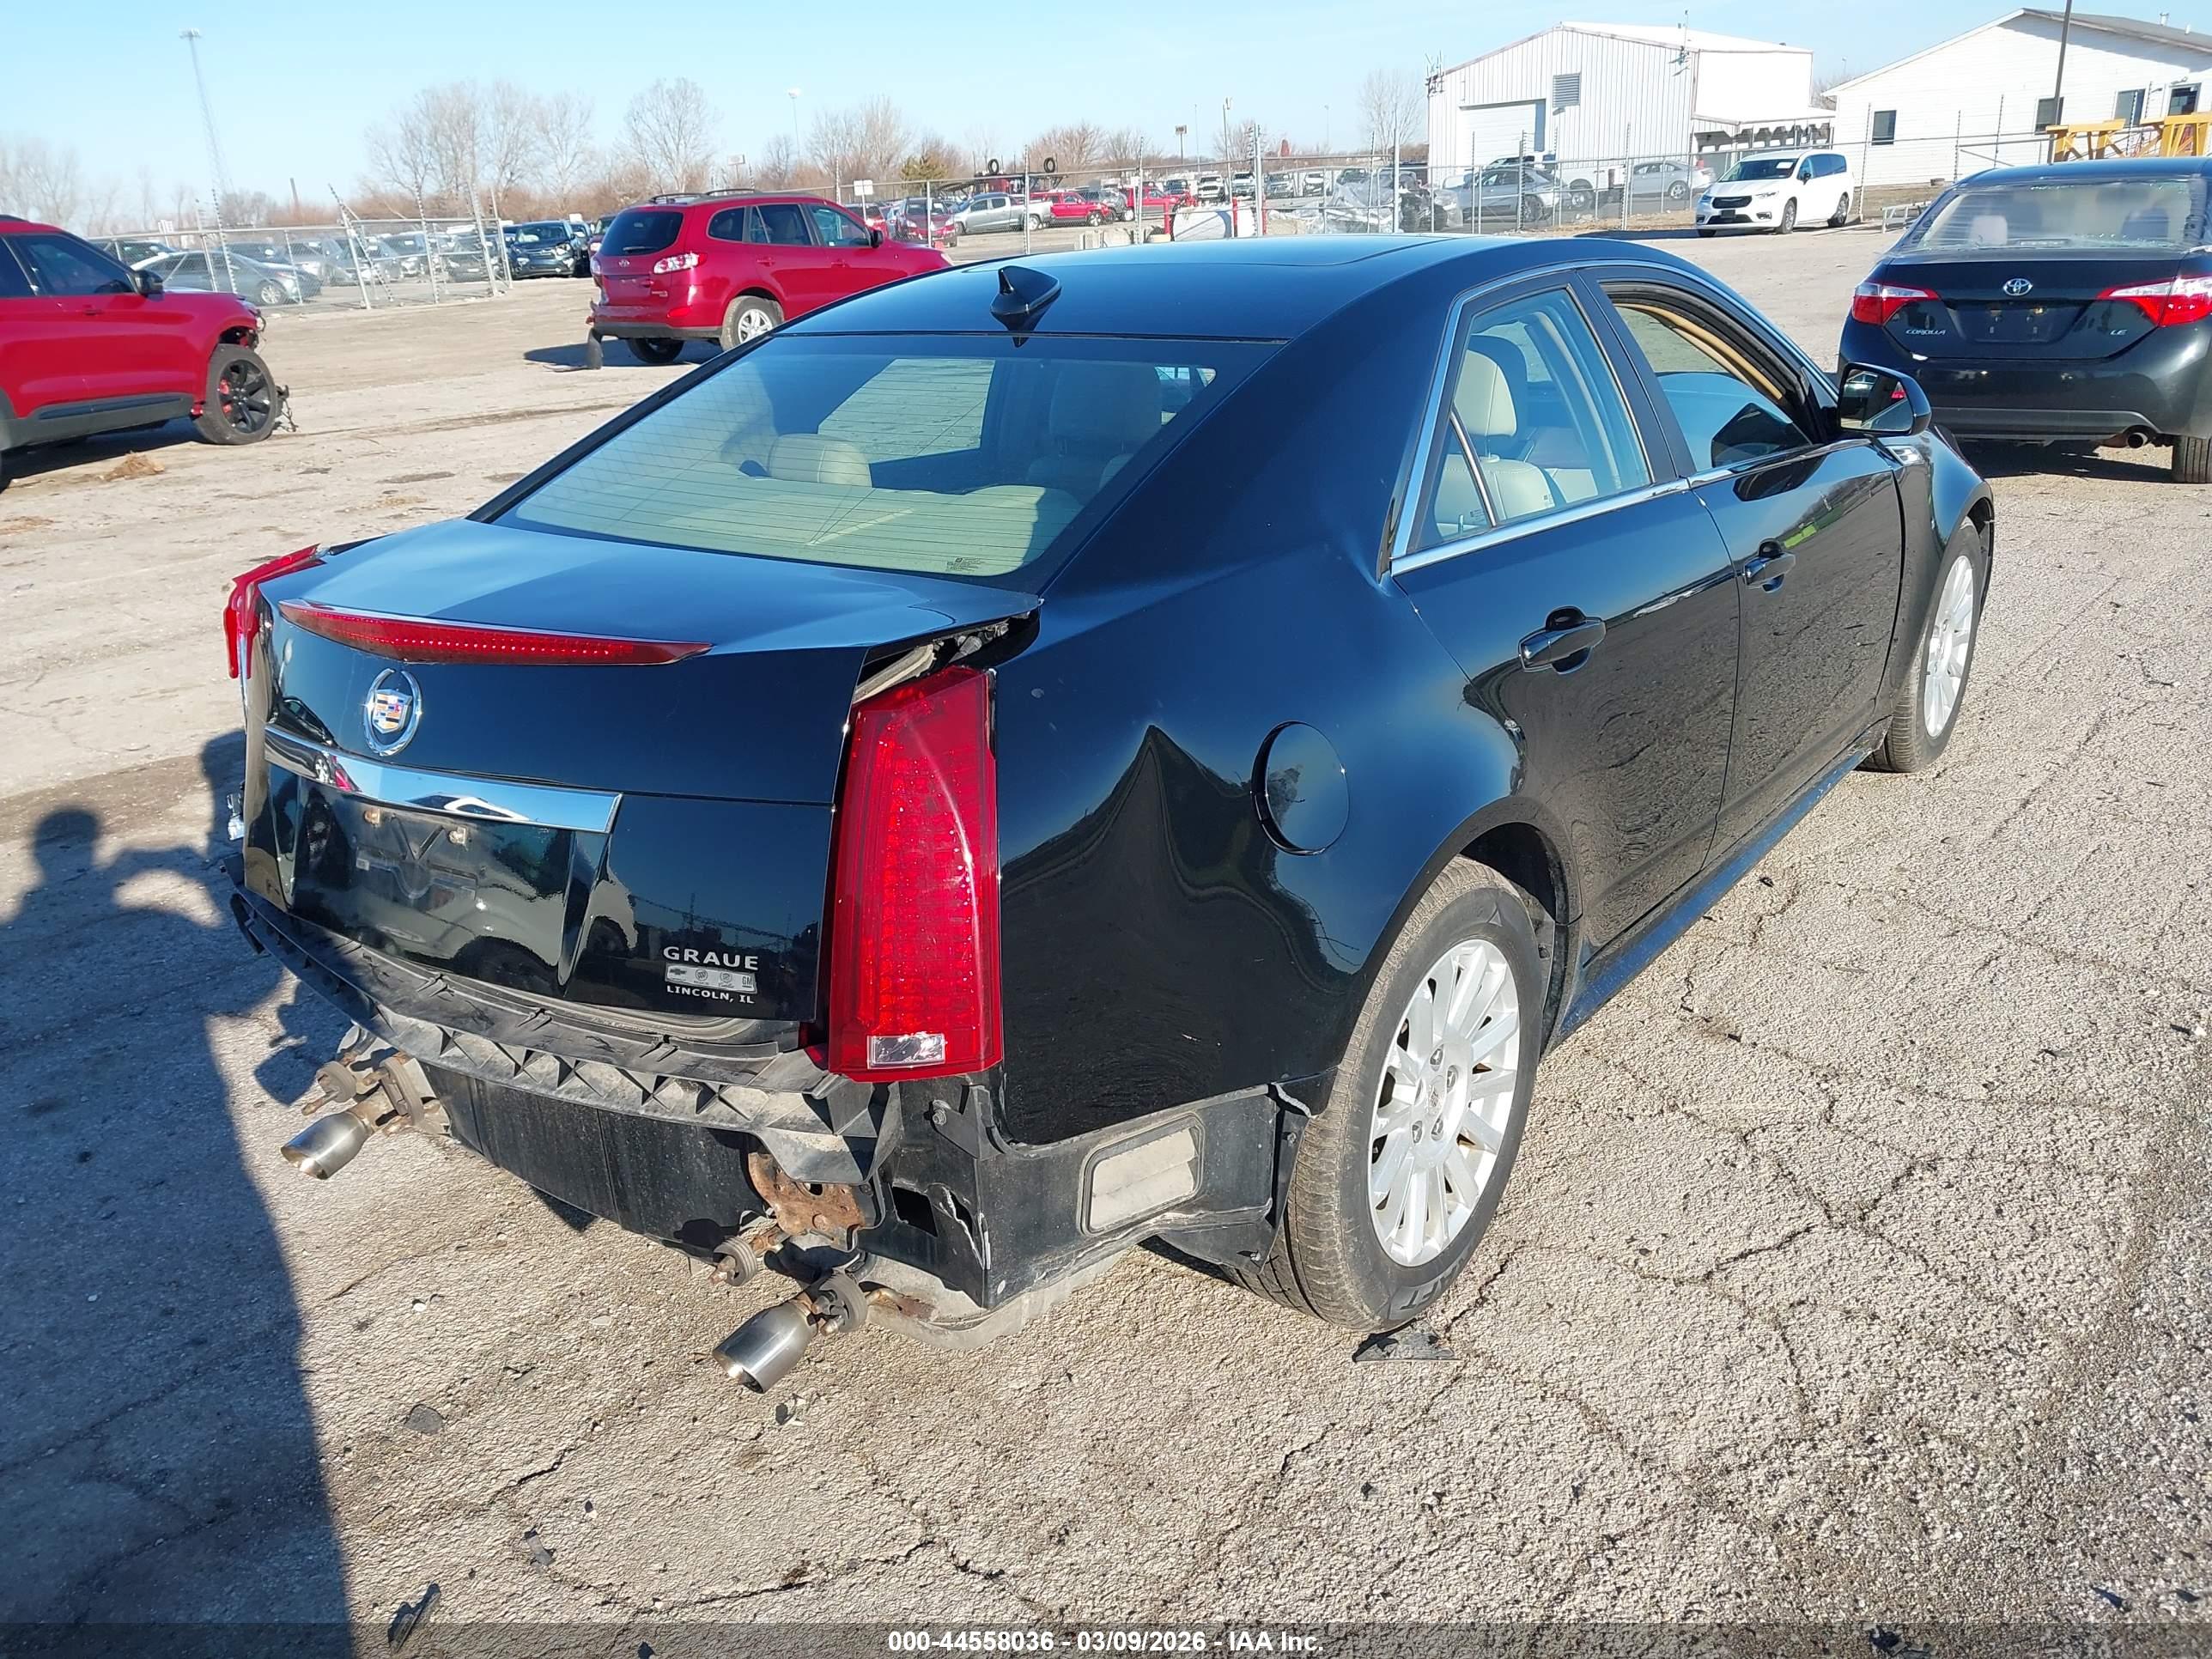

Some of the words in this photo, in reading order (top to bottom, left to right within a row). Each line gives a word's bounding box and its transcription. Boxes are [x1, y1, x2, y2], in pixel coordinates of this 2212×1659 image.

[663, 946, 758, 970] GRAUE
[666, 986, 734, 1003] LINCOLN,
[739, 994, 755, 1005] IL
